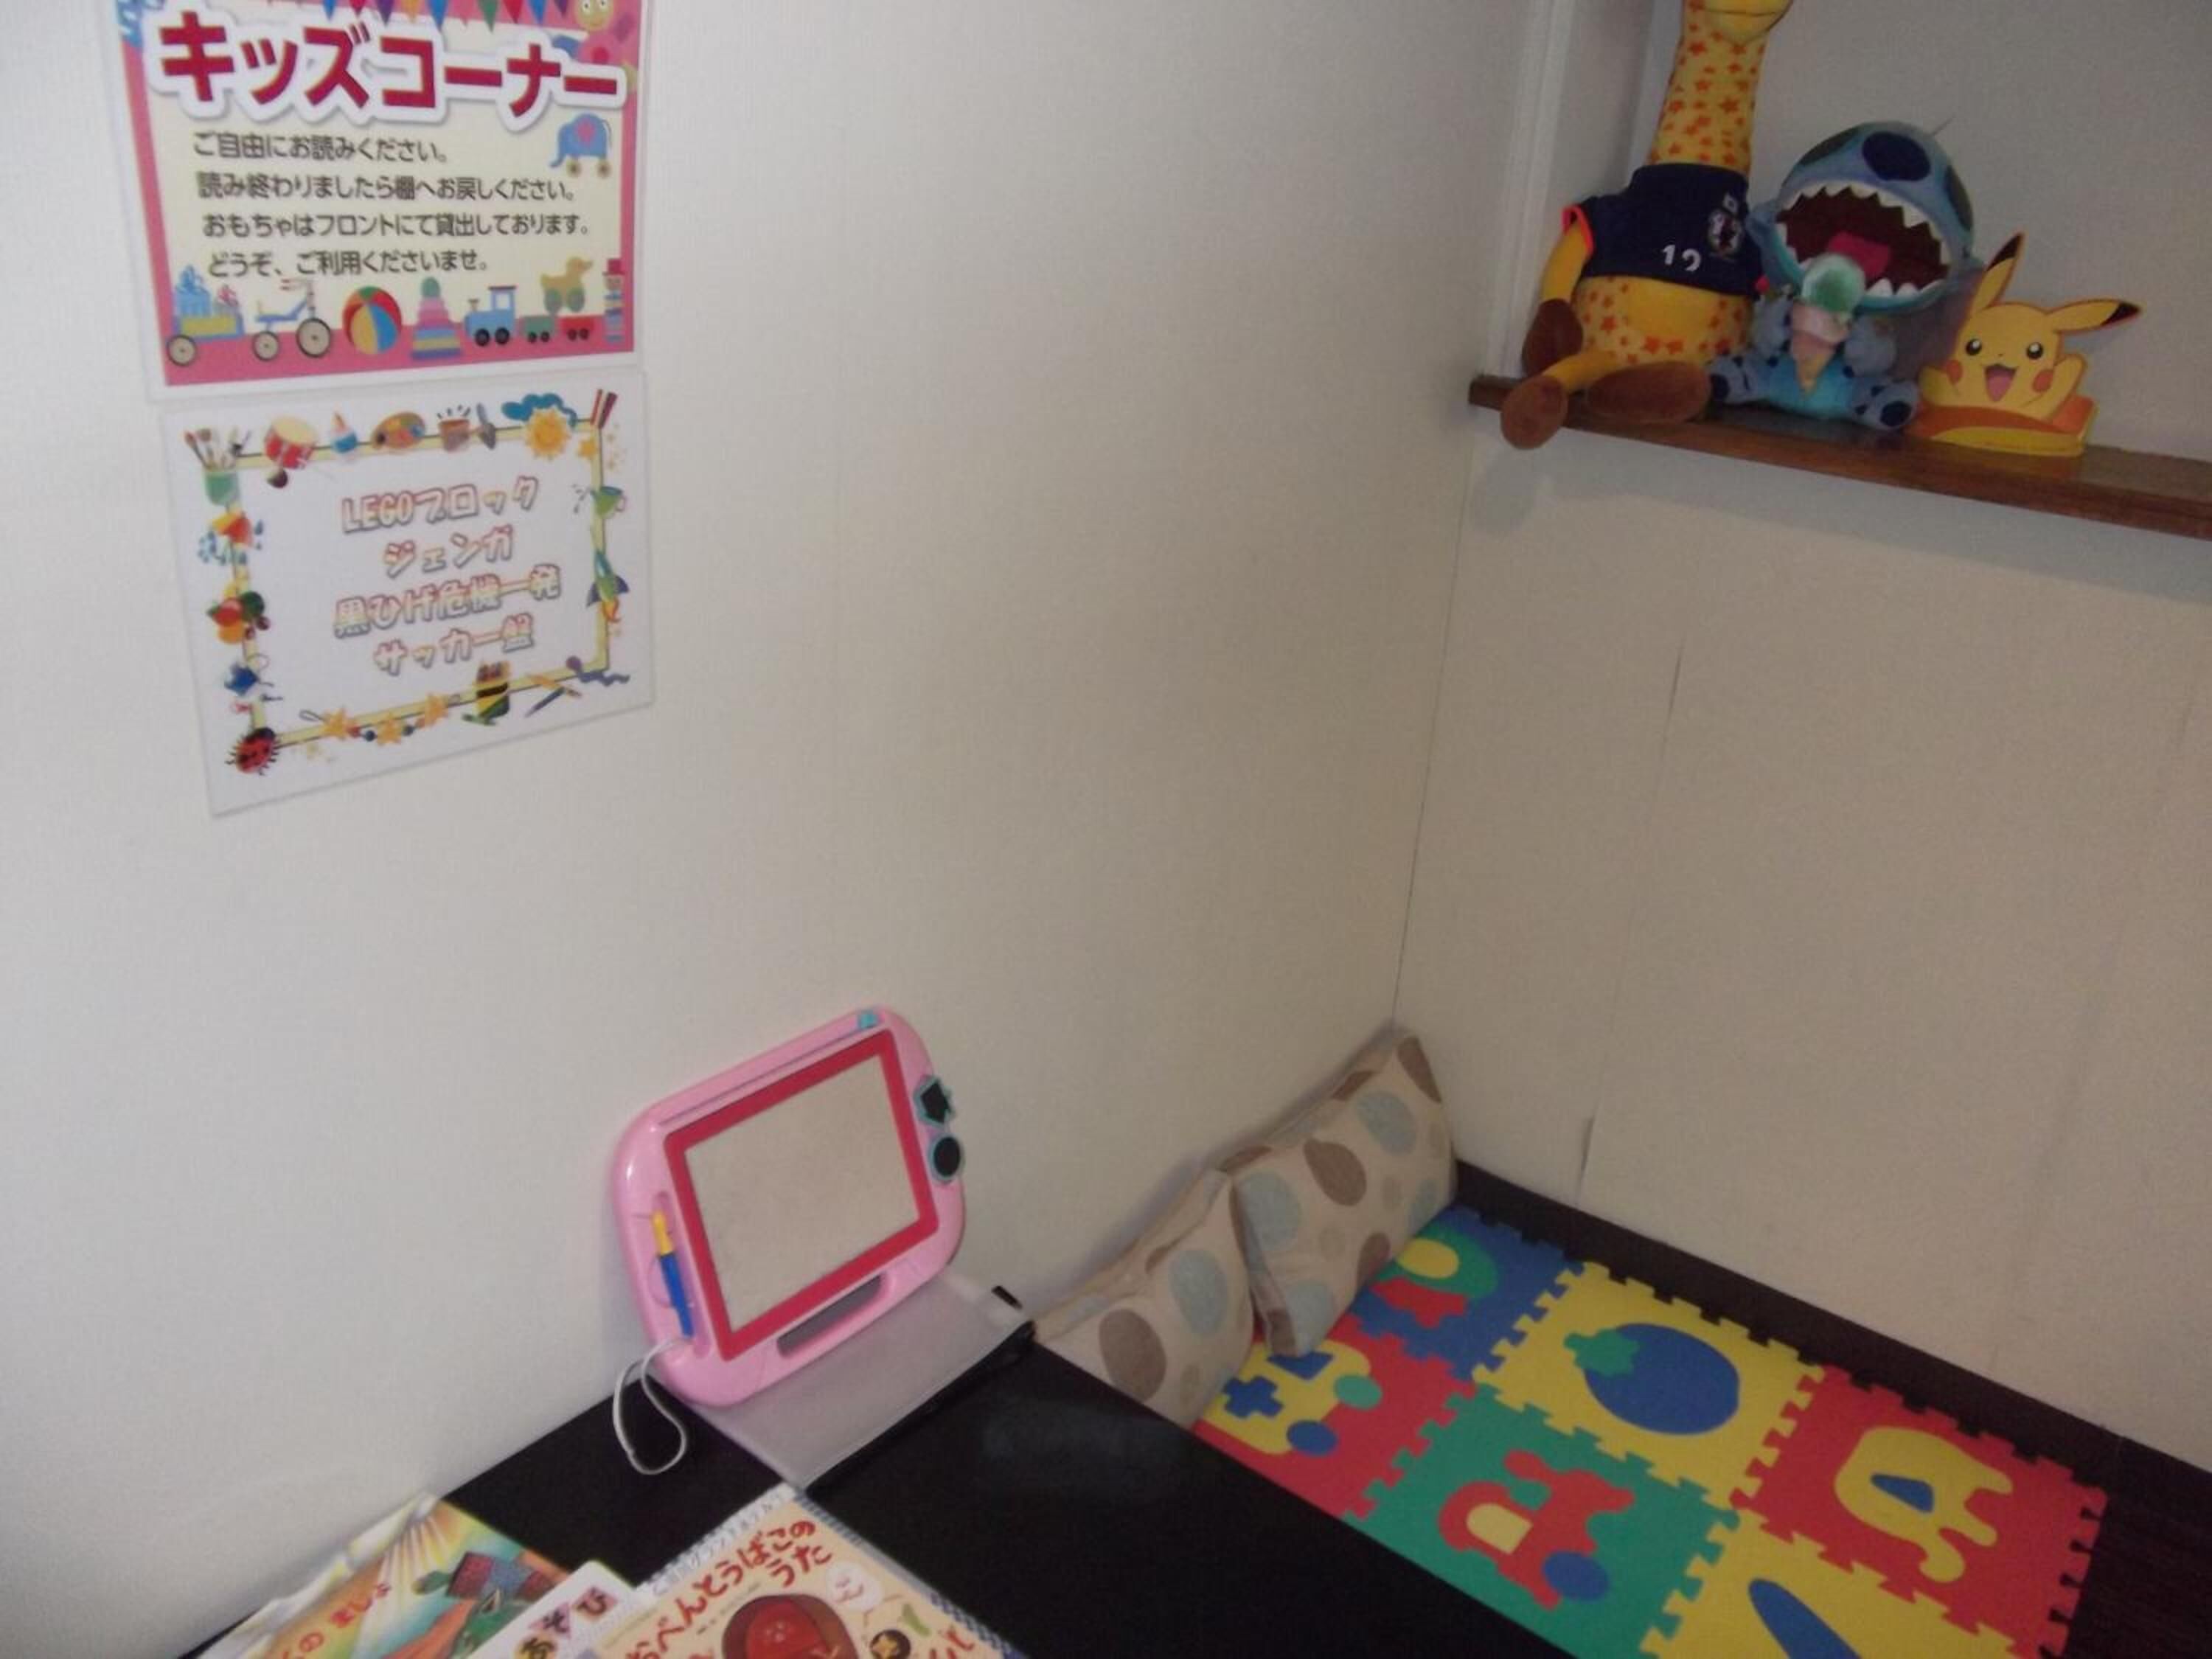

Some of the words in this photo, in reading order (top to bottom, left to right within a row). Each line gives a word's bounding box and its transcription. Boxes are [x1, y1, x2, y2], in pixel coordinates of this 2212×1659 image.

[159, 10, 618, 118] キッズコーナー
[194, 131, 447, 164] ご自由にお読みください。
[196, 171, 574, 201] 読み終わりましたら棚へお戻しください。
[203, 212, 588, 238] おもちゃはフロントにて貸出しております。
[209, 248, 487, 278] どうぞ、ご利用くださいませ。
[383, 524, 514, 580] ジェンガ
[766, 1545, 832, 1587] うた
